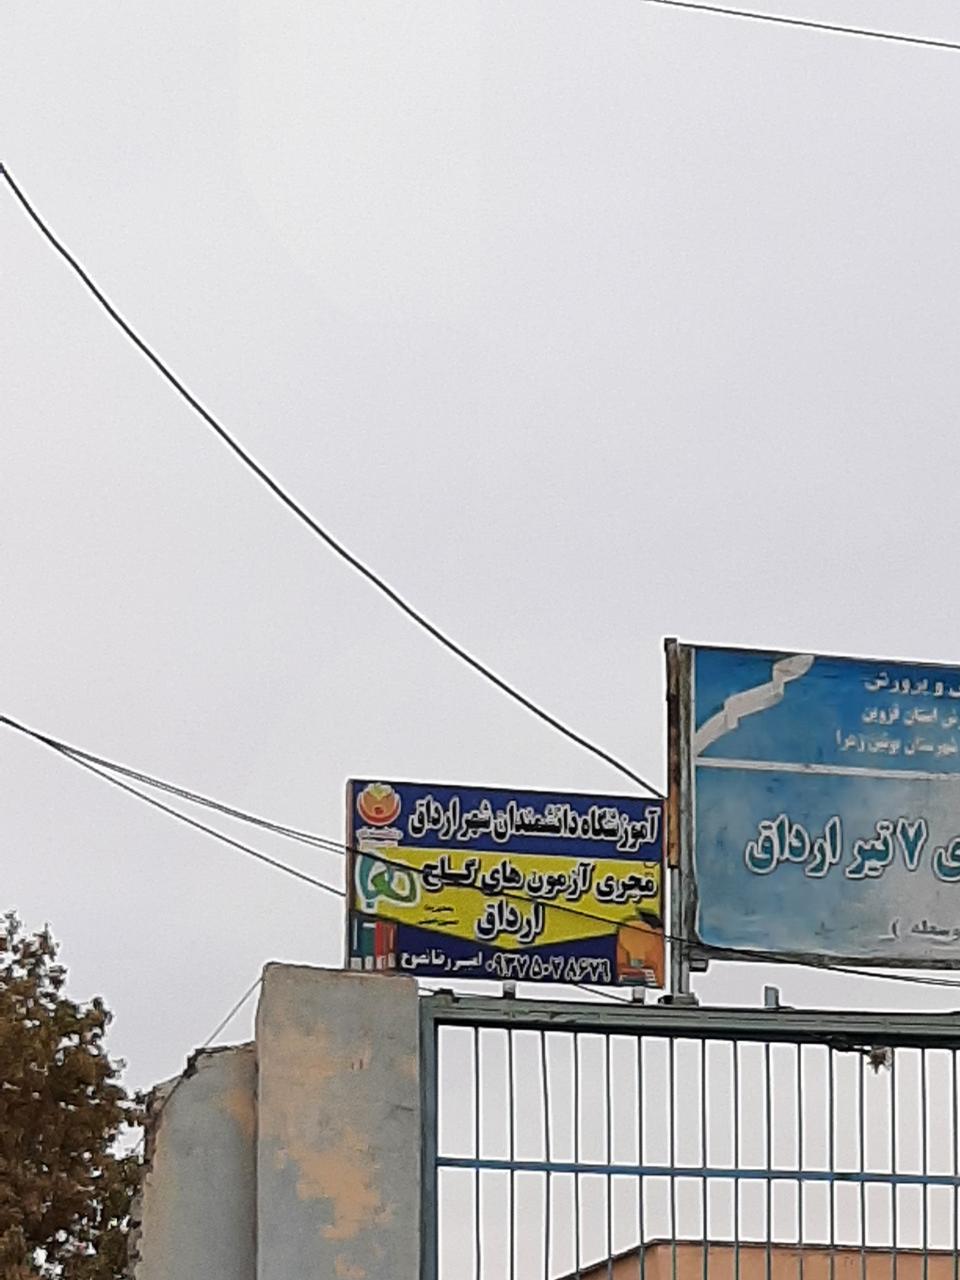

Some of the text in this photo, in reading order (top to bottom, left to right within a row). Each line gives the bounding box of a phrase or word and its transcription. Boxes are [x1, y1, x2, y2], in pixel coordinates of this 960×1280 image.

[865, 672, 928, 695] پرورش
[933, 681, 943, 697] و
[408, 795, 661, 851] آموزشگاه دانشمندان شهر ارداق
[744, 813, 842, 877] ارداق
[845, 818, 894, 880] تیر
[899, 817, 928, 871] ۷
[480, 859, 525, 897] های
[526, 861, 596, 900] آزمون
[596, 873, 658, 902] مجری
[475, 899, 546, 943] ارداق
